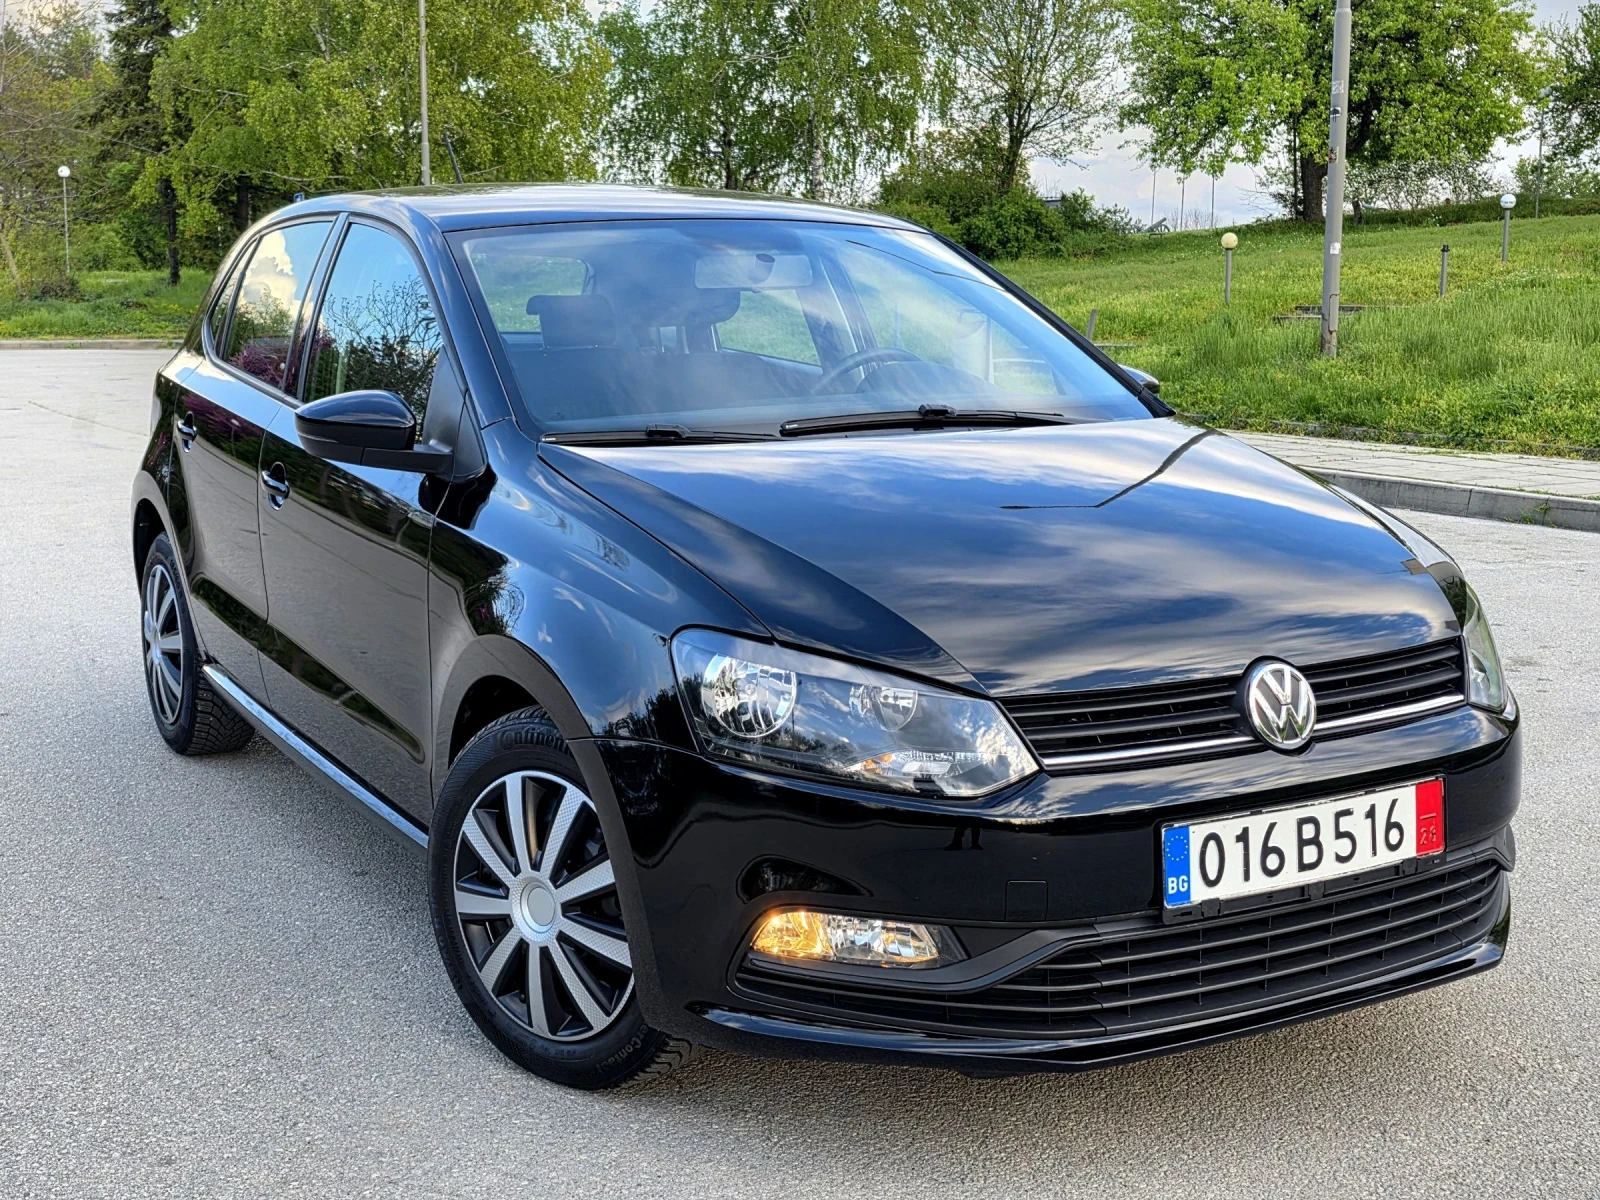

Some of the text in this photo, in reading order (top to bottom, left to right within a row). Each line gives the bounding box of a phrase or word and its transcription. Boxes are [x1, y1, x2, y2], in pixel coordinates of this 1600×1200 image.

[1251, 665, 1312, 746] VW
[1199, 798, 1405, 888] 016B516
[1168, 875, 1189, 895] BG
